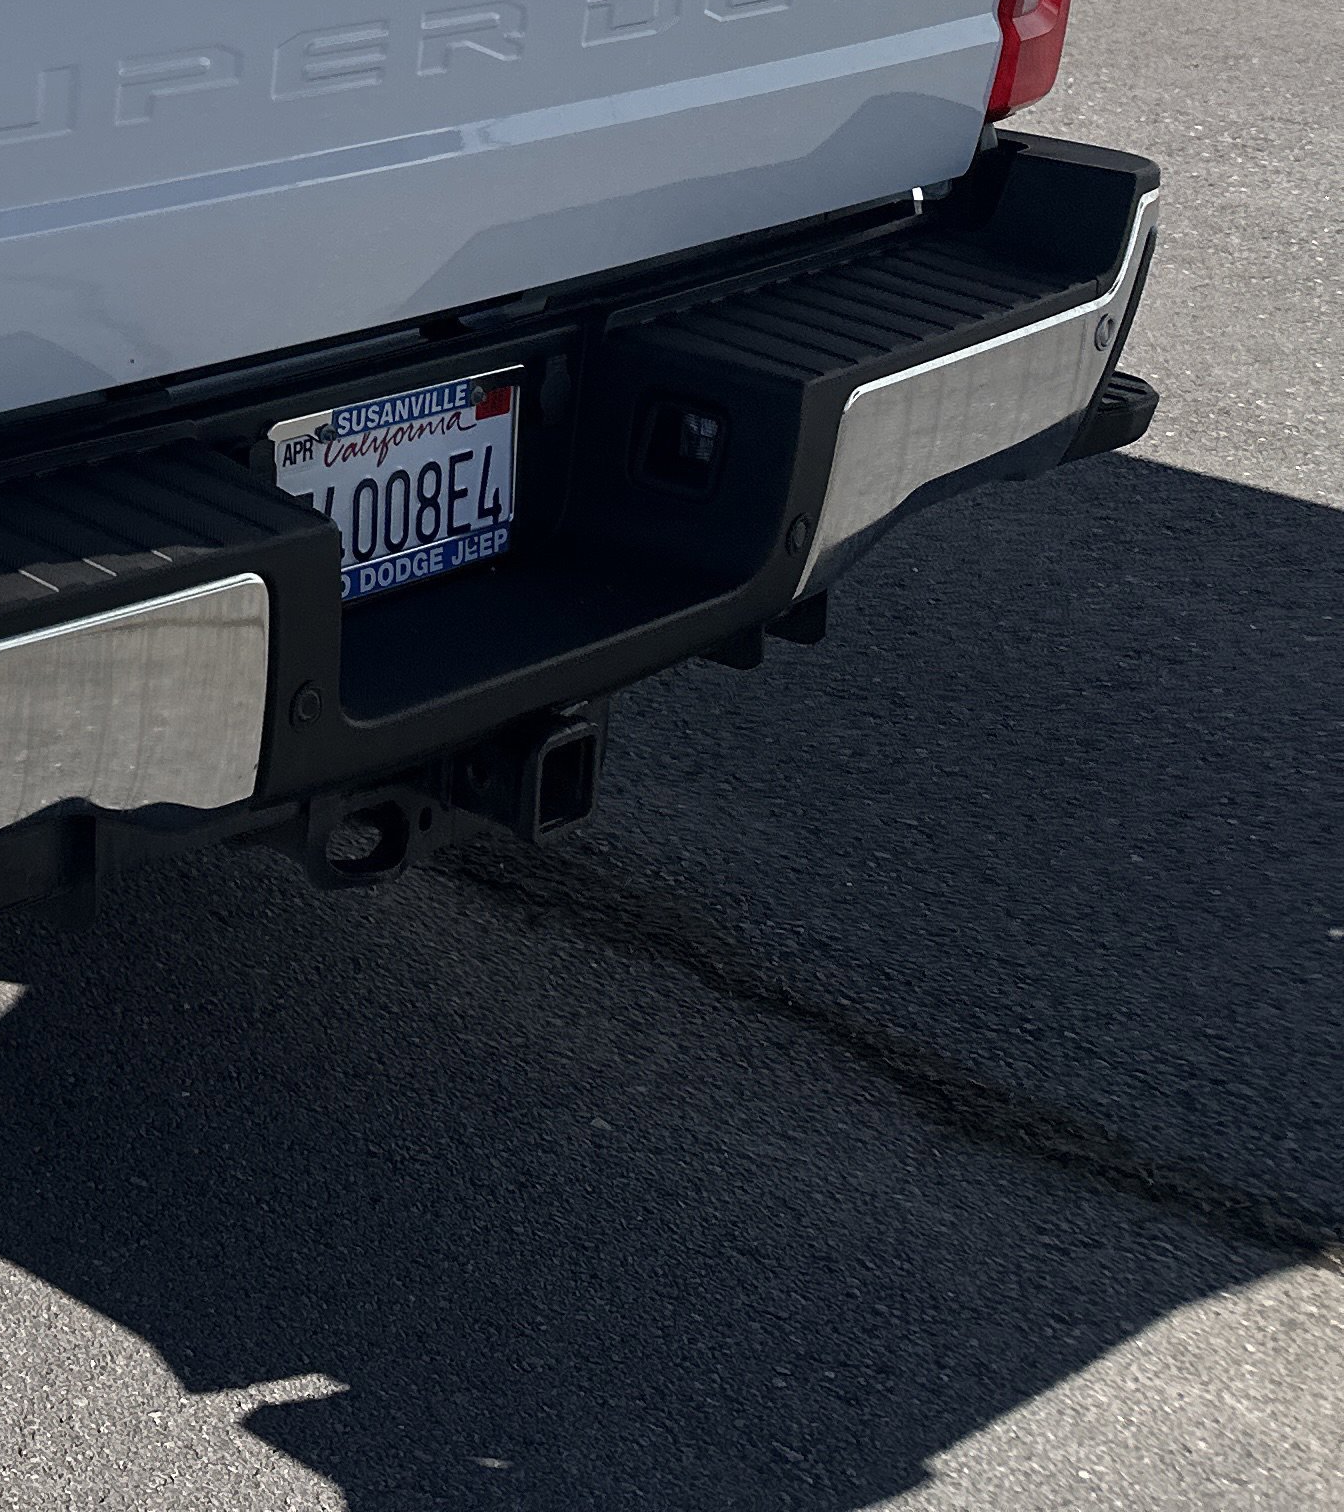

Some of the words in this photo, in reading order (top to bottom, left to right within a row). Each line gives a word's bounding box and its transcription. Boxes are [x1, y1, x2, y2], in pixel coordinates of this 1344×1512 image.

[336, 383, 468, 436] SUSANVILLE
[282, 440, 314, 468] APR
[323, 410, 477, 468] California
[359, 546, 444, 594] DODGE
[451, 527, 509, 567] JEEP
